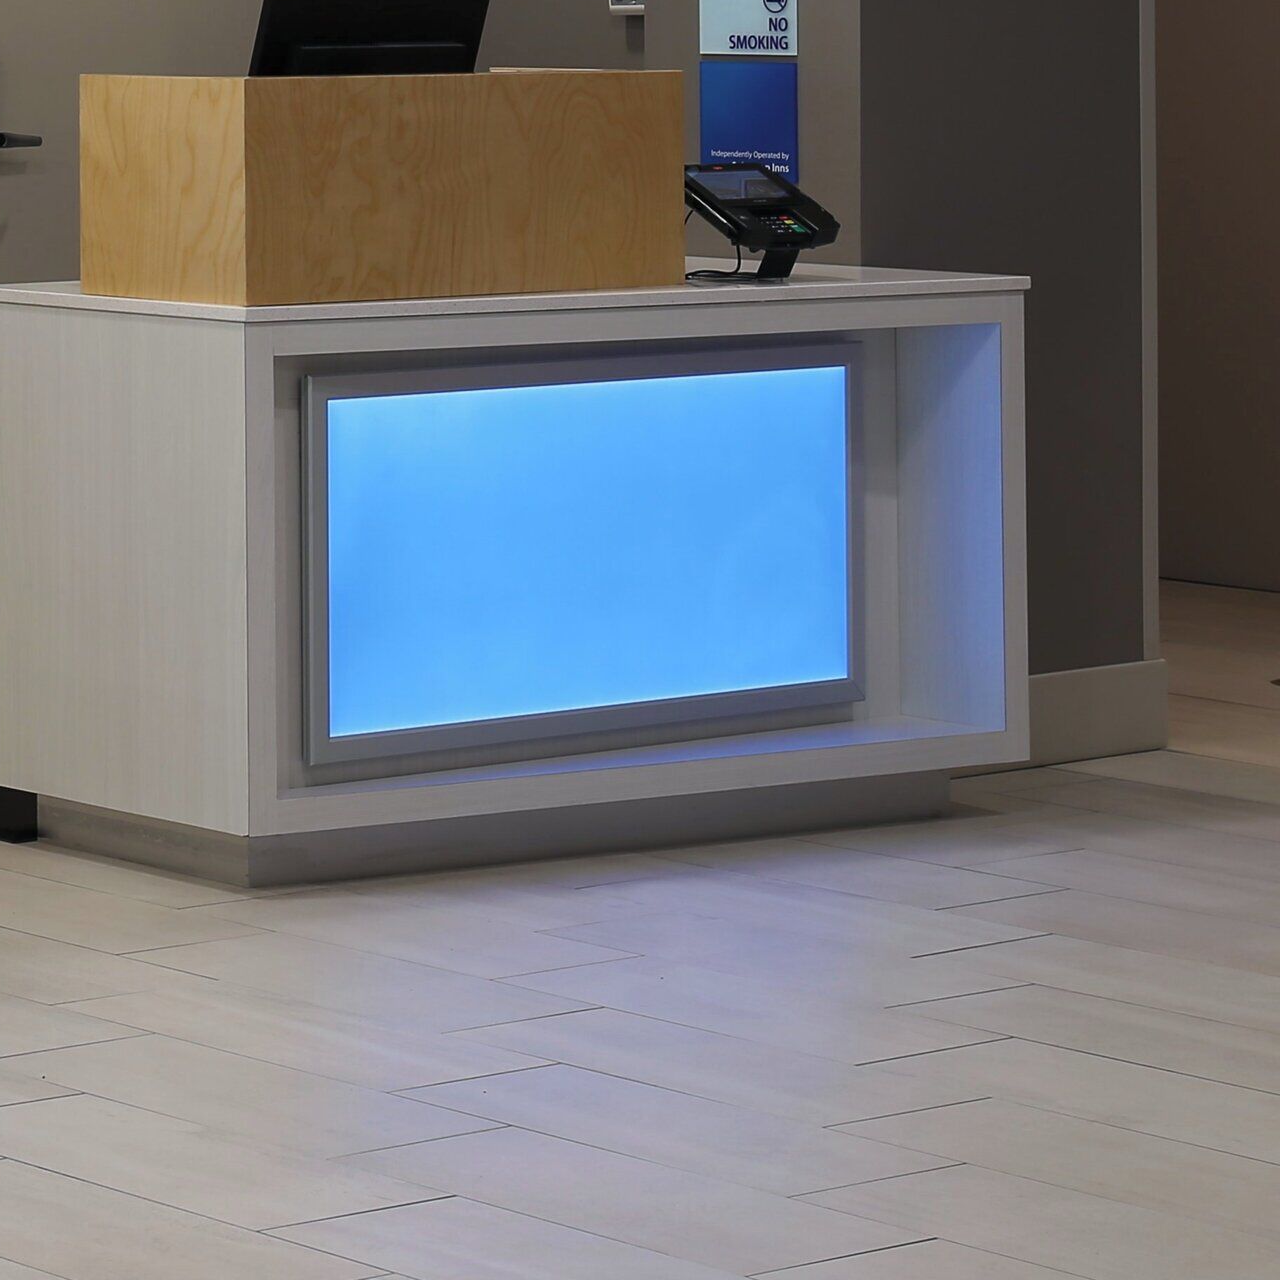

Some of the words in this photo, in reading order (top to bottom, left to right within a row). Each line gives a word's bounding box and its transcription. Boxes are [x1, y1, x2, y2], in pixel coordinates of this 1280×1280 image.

[768, 17, 788, 32] NO
[728, 34, 789, 50] SMOKING
[710, 149, 752, 159] Independently
[753, 151, 781, 160] Operated
[781, 152, 790, 160] by
[771, 163, 790, 173] Inns
